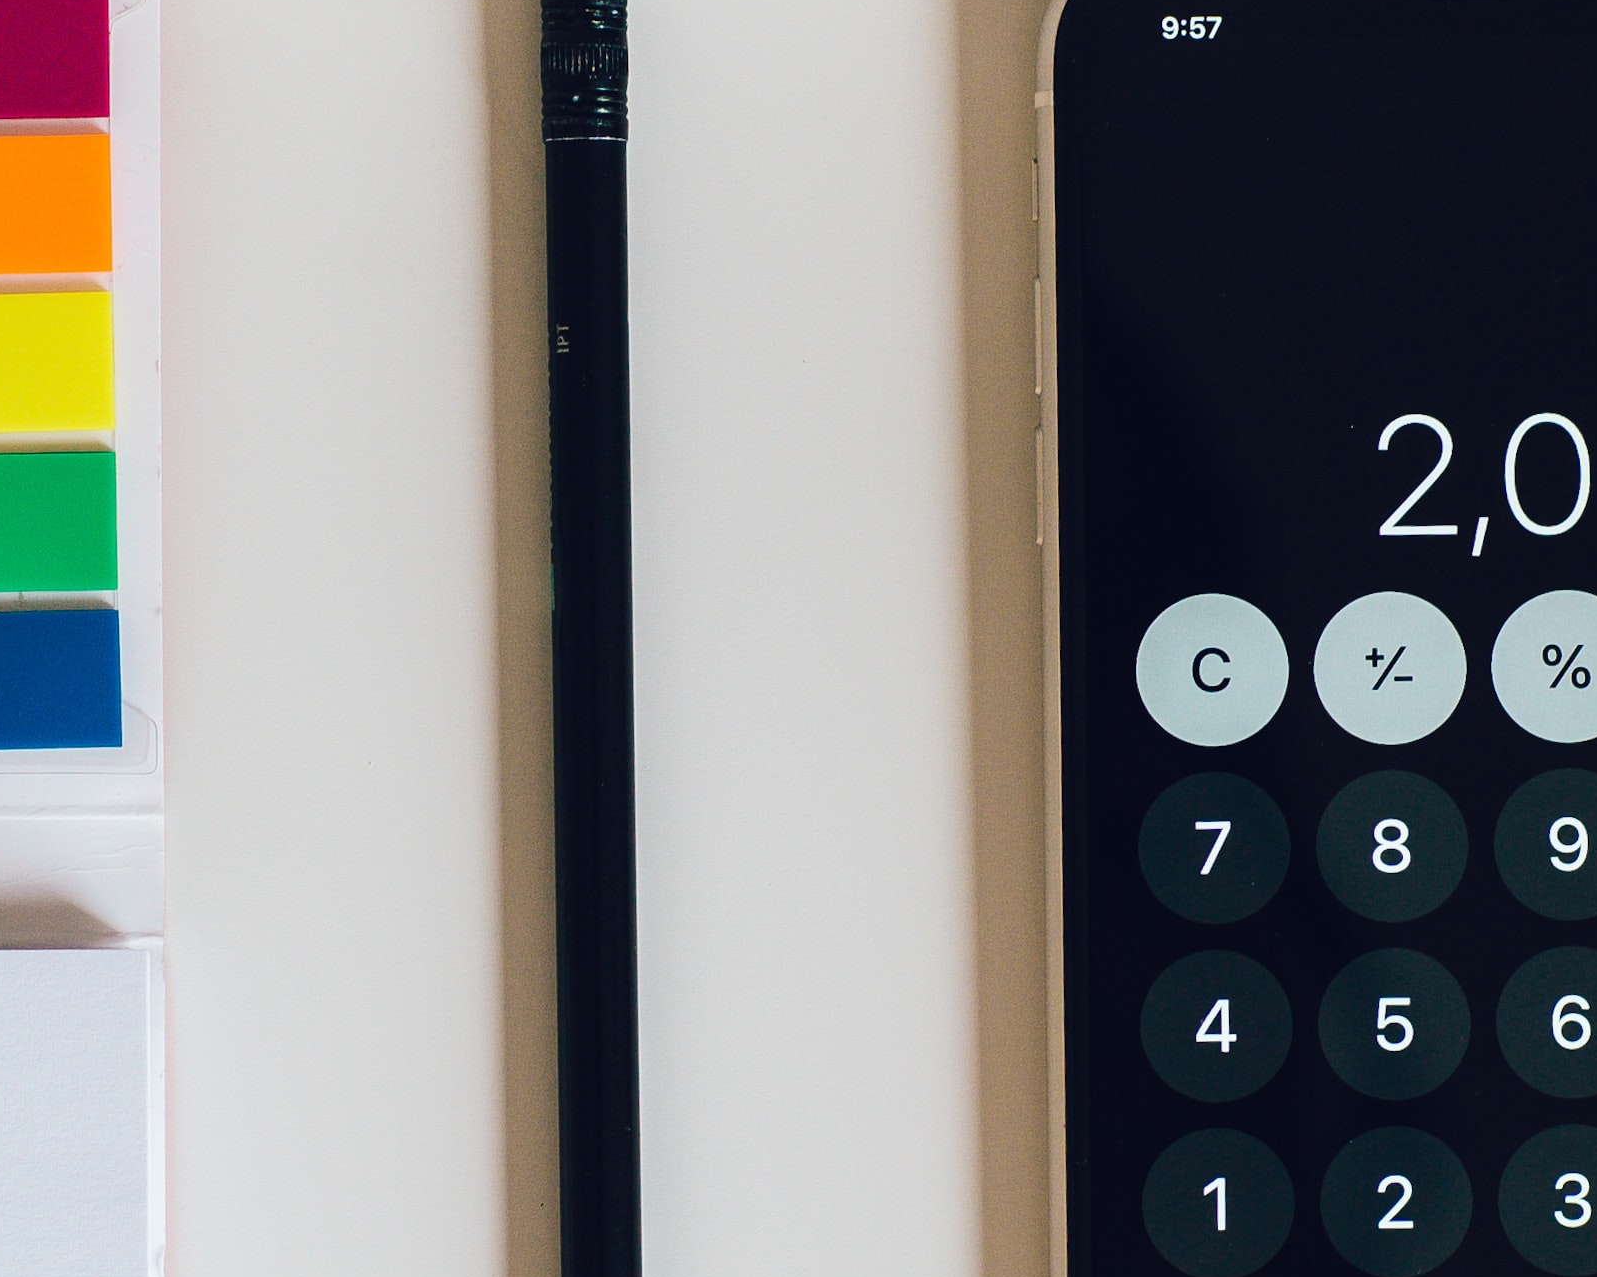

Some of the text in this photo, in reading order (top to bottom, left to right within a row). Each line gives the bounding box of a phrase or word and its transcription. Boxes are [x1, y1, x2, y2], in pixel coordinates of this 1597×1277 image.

[1161, 15, 1223, 40] 9:57
[556, 323, 570, 353] IPT
[1191, 647, 1231, 693] C
[1542, 644, 1592, 690] %
[1194, 820, 1232, 875] 7
[1372, 818, 1411, 874] 8
[1548, 816, 1589, 872] 9
[1195, 999, 1238, 1053] 4
[1376, 997, 1414, 1052] 5
[1551, 994, 1592, 1050] 6
[1203, 1177, 1226, 1231] 1
[1377, 1174, 1414, 1230] 2
[1554, 1172, 1592, 1228] 3
